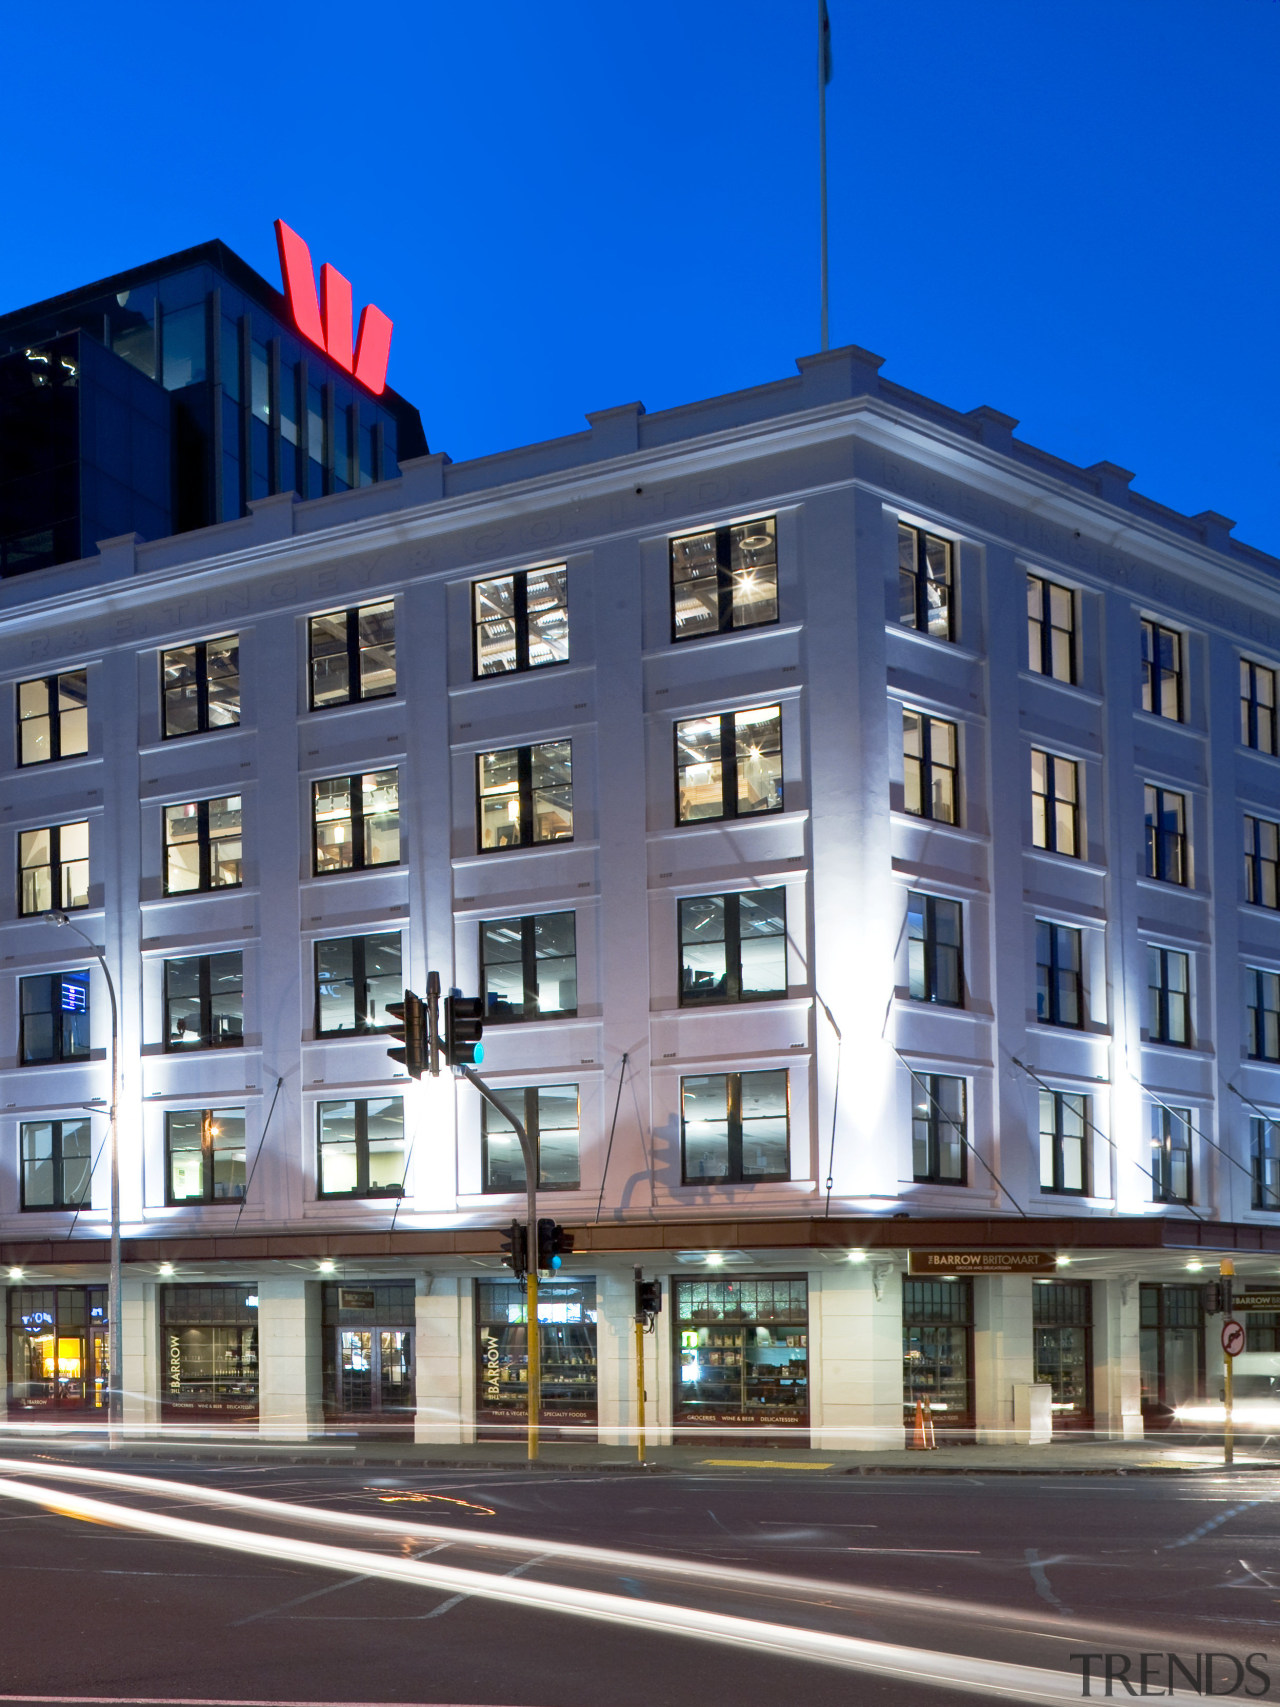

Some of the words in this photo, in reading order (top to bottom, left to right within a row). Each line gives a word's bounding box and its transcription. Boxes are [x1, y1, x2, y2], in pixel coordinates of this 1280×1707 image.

[161, 554, 386, 626] TINGEY
[933, 1255, 981, 1265] BARROW
[983, 1254, 1039, 1265] BRITOMART
[1236, 1296, 1270, 1304] BARROW
[171, 1335, 180, 1388] BARROW
[488, 1336, 500, 1393] BARROW
